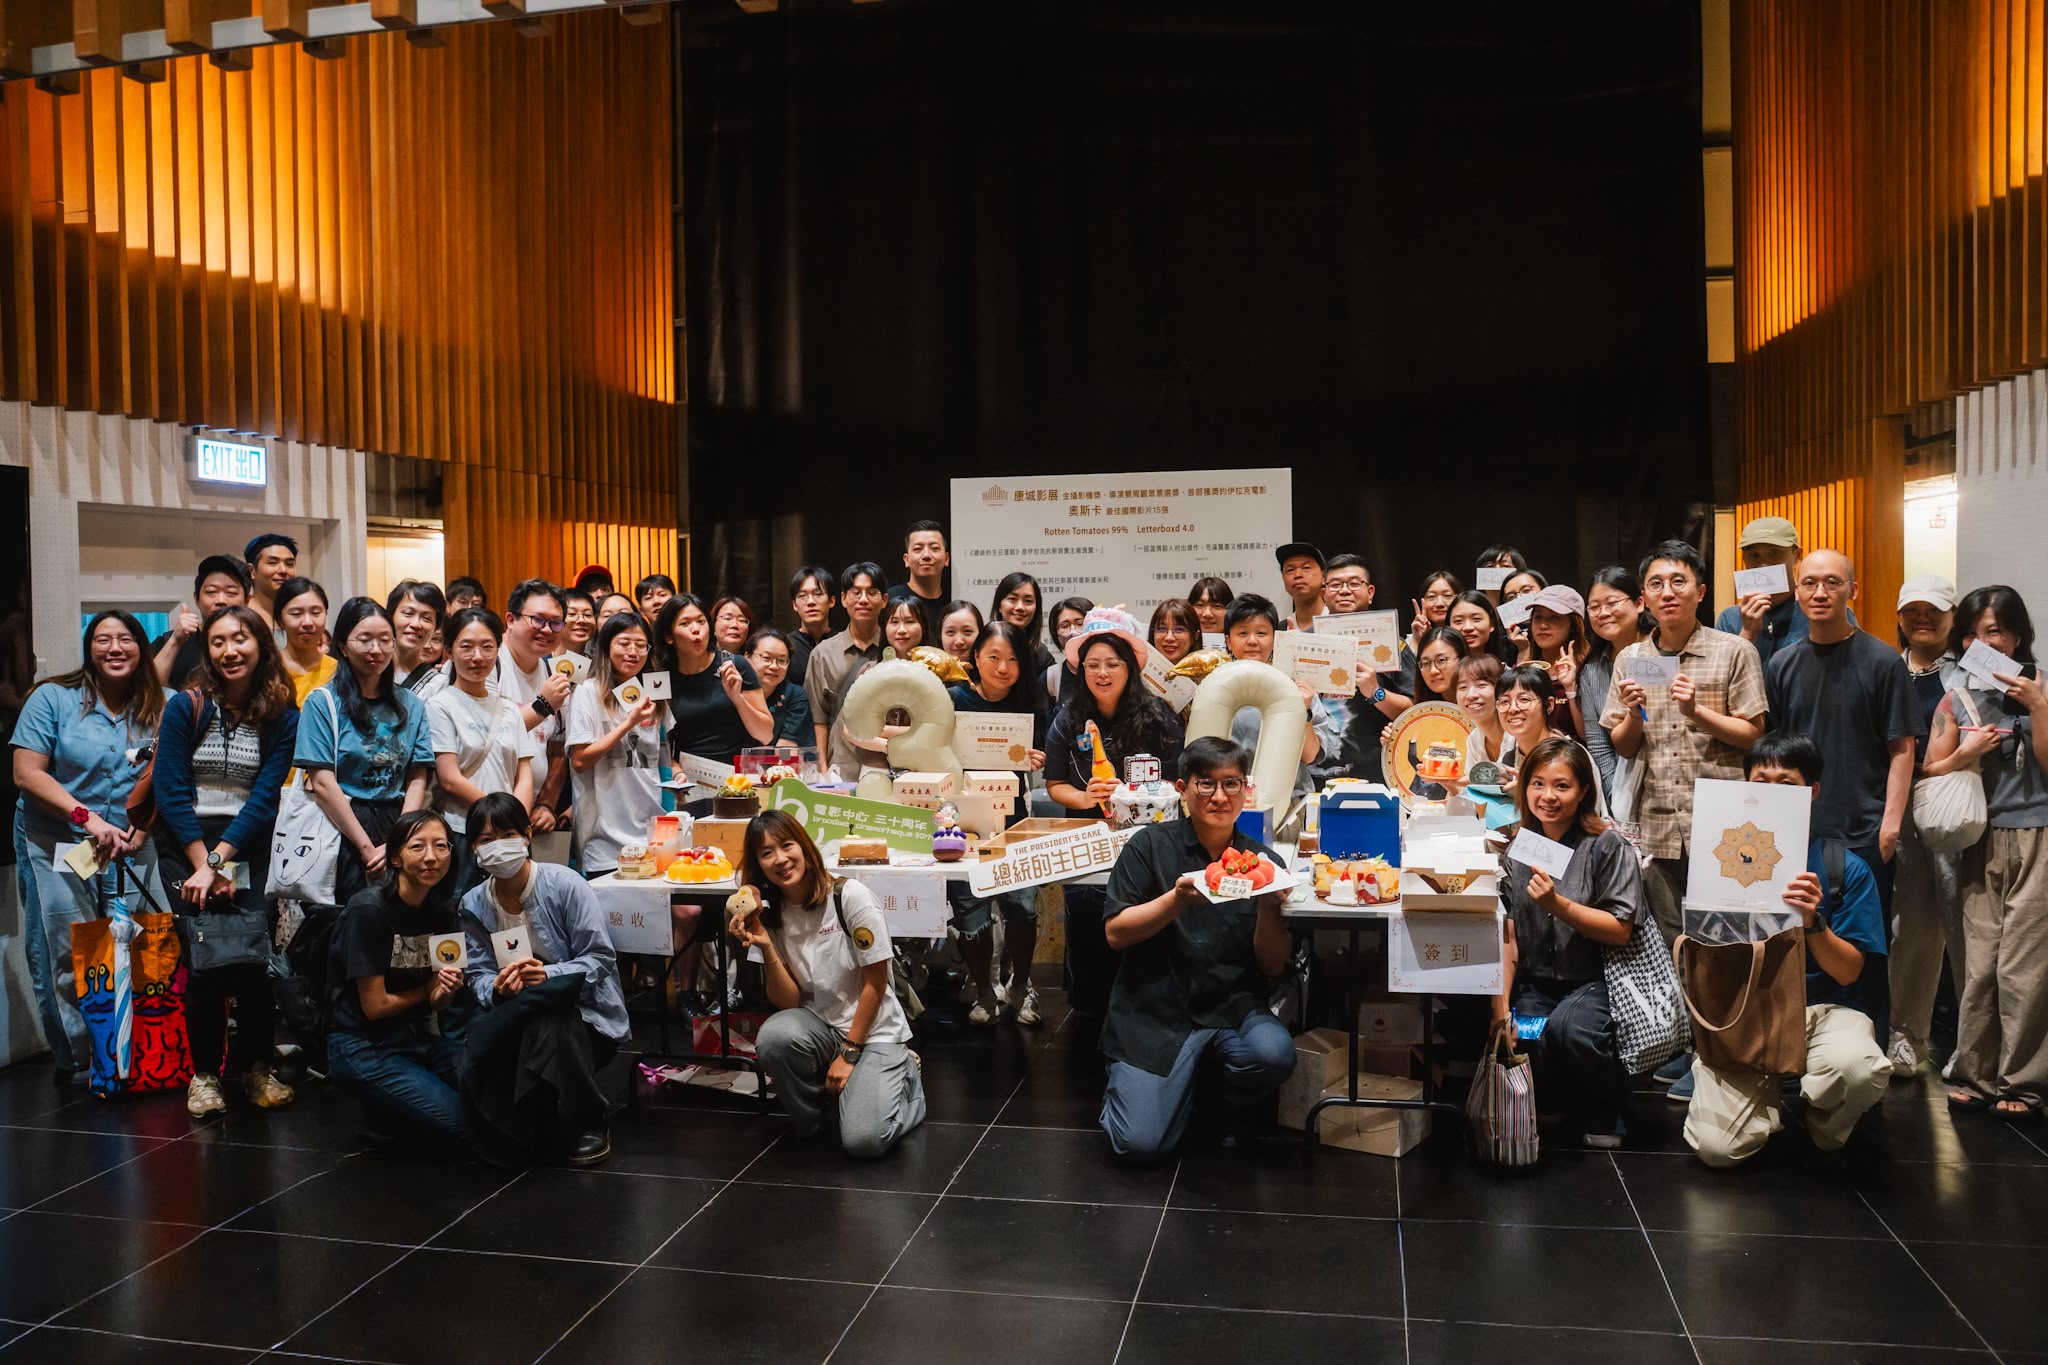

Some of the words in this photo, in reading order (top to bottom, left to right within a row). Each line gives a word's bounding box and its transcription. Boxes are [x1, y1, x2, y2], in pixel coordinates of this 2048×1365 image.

[203, 444, 233, 477] EXIT
[235, 449, 261, 481] 出口
[1013, 489, 1059, 502] 康城影展
[1068, 505, 1102, 517] 奧斯卡
[1044, 527, 1071, 536] Rotten
[1072, 526, 1110, 536] Tomatoes
[1111, 525, 1129, 534] 99%
[1137, 524, 1180, 534] Letterboxd
[1182, 523, 1195, 533] 4.0
[1130, 761, 1159, 782] BC
[813, 803, 870, 823] 電影中心
[874, 815, 928, 831] 三十周年
[813, 815, 853, 829] broadwa
[1014, 846, 1029, 855] THE
[1030, 833, 1080, 852] PRESIDENT'S
[1081, 829, 1102, 840] CAKE
[883, 895, 919, 912] 進貢
[609, 911, 645, 928] 驗收
[1424, 943, 1469, 963] 簽到
